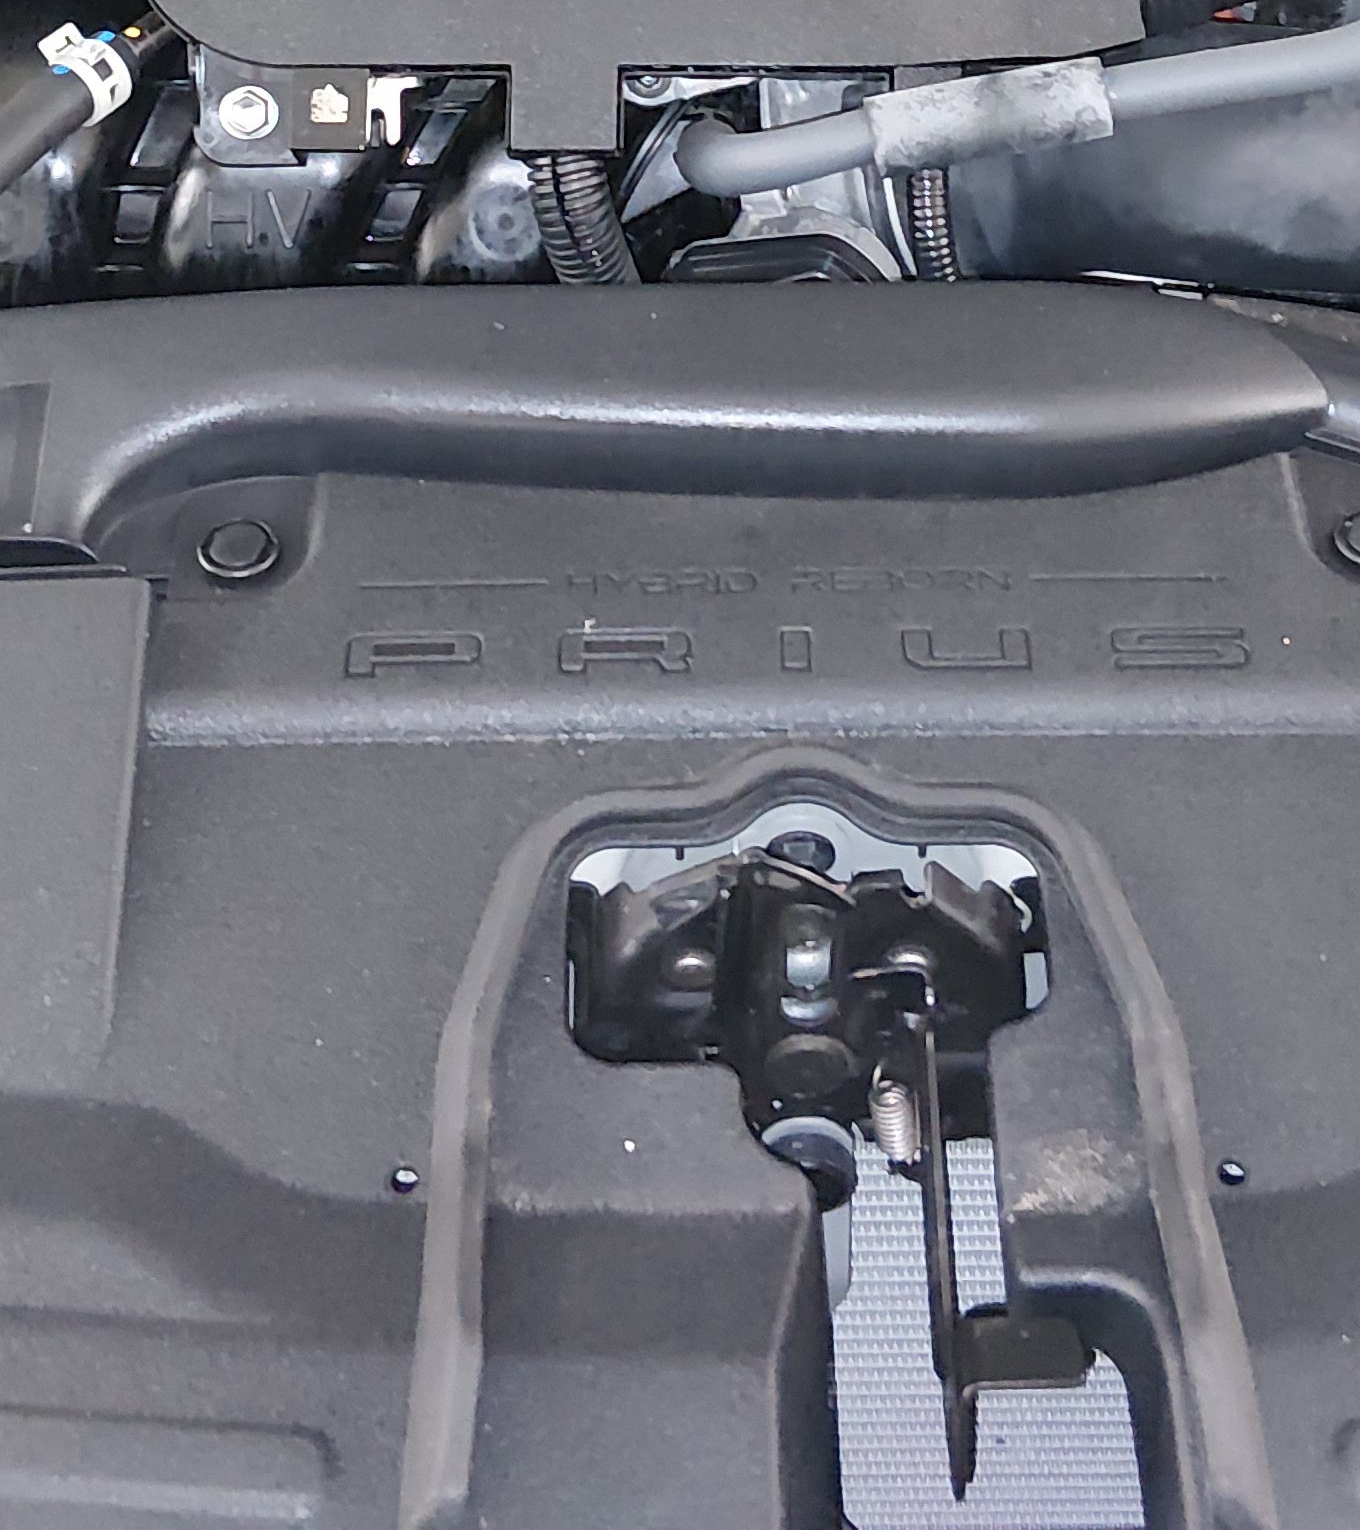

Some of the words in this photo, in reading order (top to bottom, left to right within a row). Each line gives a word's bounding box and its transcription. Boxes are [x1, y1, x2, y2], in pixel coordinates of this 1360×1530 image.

[206, 189, 312, 249] HV
[568, 568, 758, 594] HYBRID
[790, 567, 1011, 592] REBORN
[343, 624, 1250, 678] PRIUS
